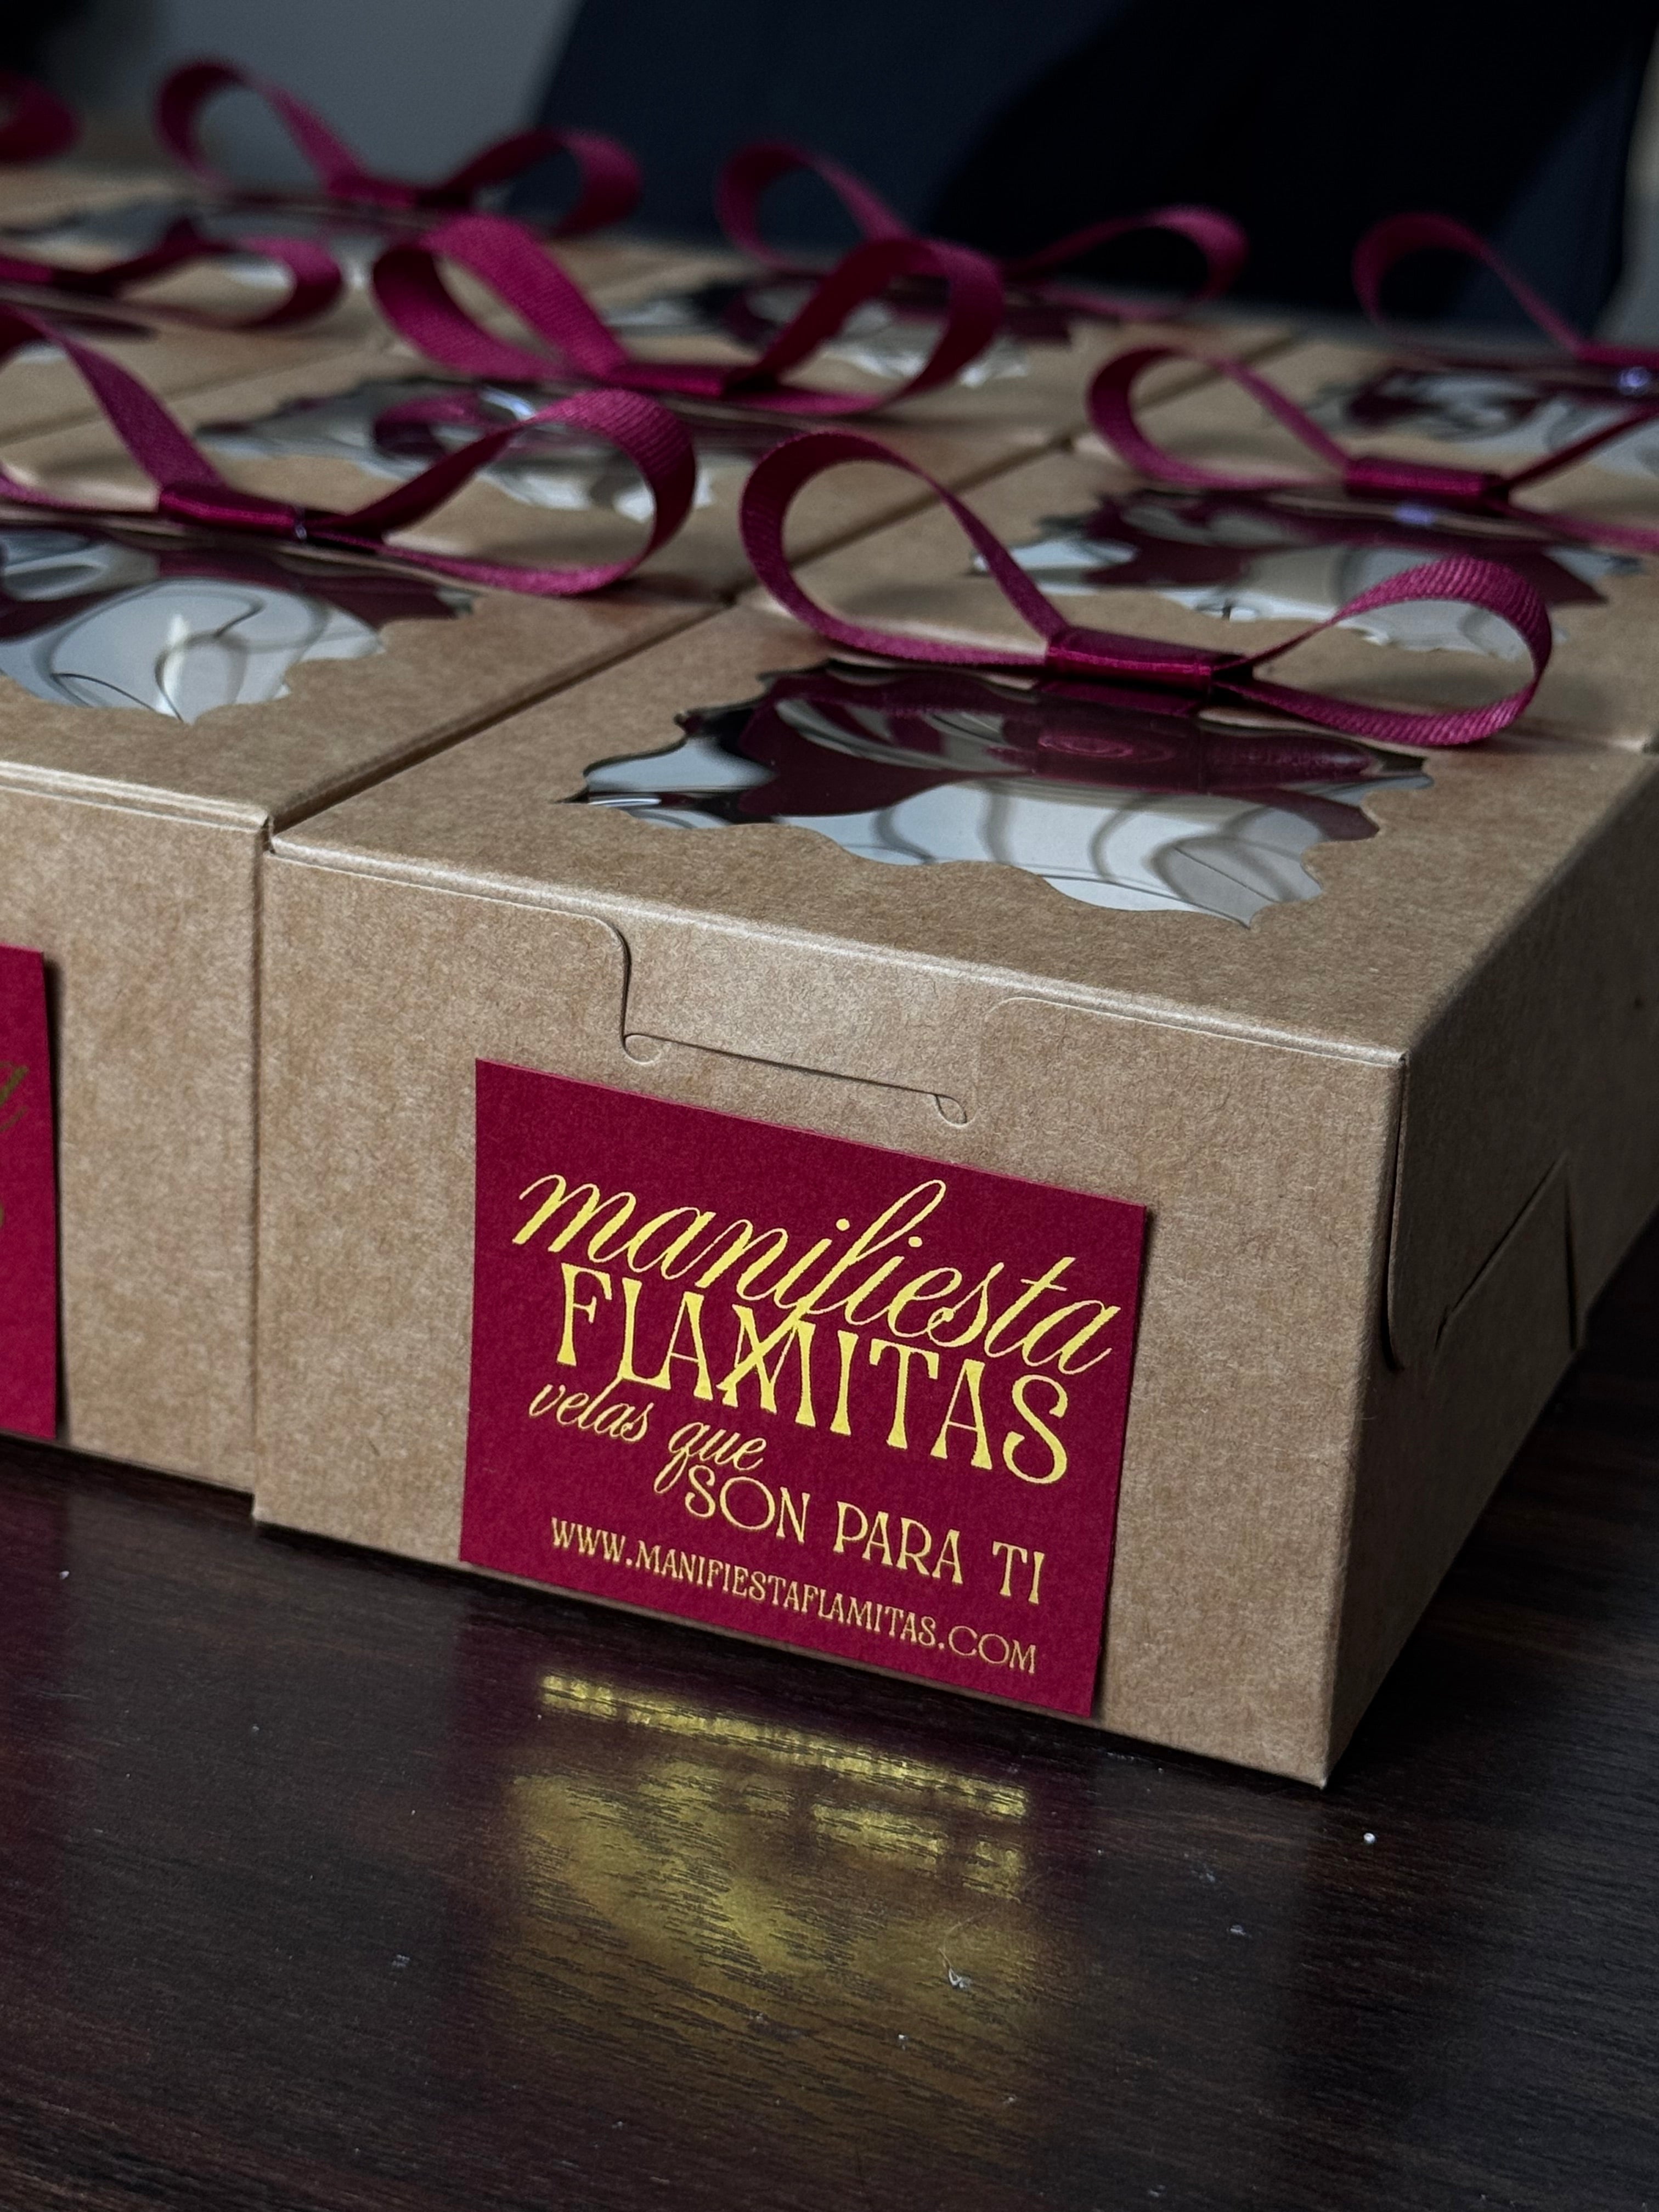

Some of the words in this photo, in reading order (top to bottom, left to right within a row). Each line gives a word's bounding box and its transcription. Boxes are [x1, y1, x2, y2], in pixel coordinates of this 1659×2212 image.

[512, 1174, 1121, 1391] manifiesta
[528, 1377, 654, 1442] velas
[654, 1421, 766, 1493] que
[557, 1262, 1068, 1484] FLAMITAS
[551, 1517, 1037, 1675] WWW.MANIFIESTAFLAMITAS.COM
[685, 1464, 809, 1542] SON
[833, 1500, 963, 1584] PARA
[992, 1542, 1046, 1605] TI
